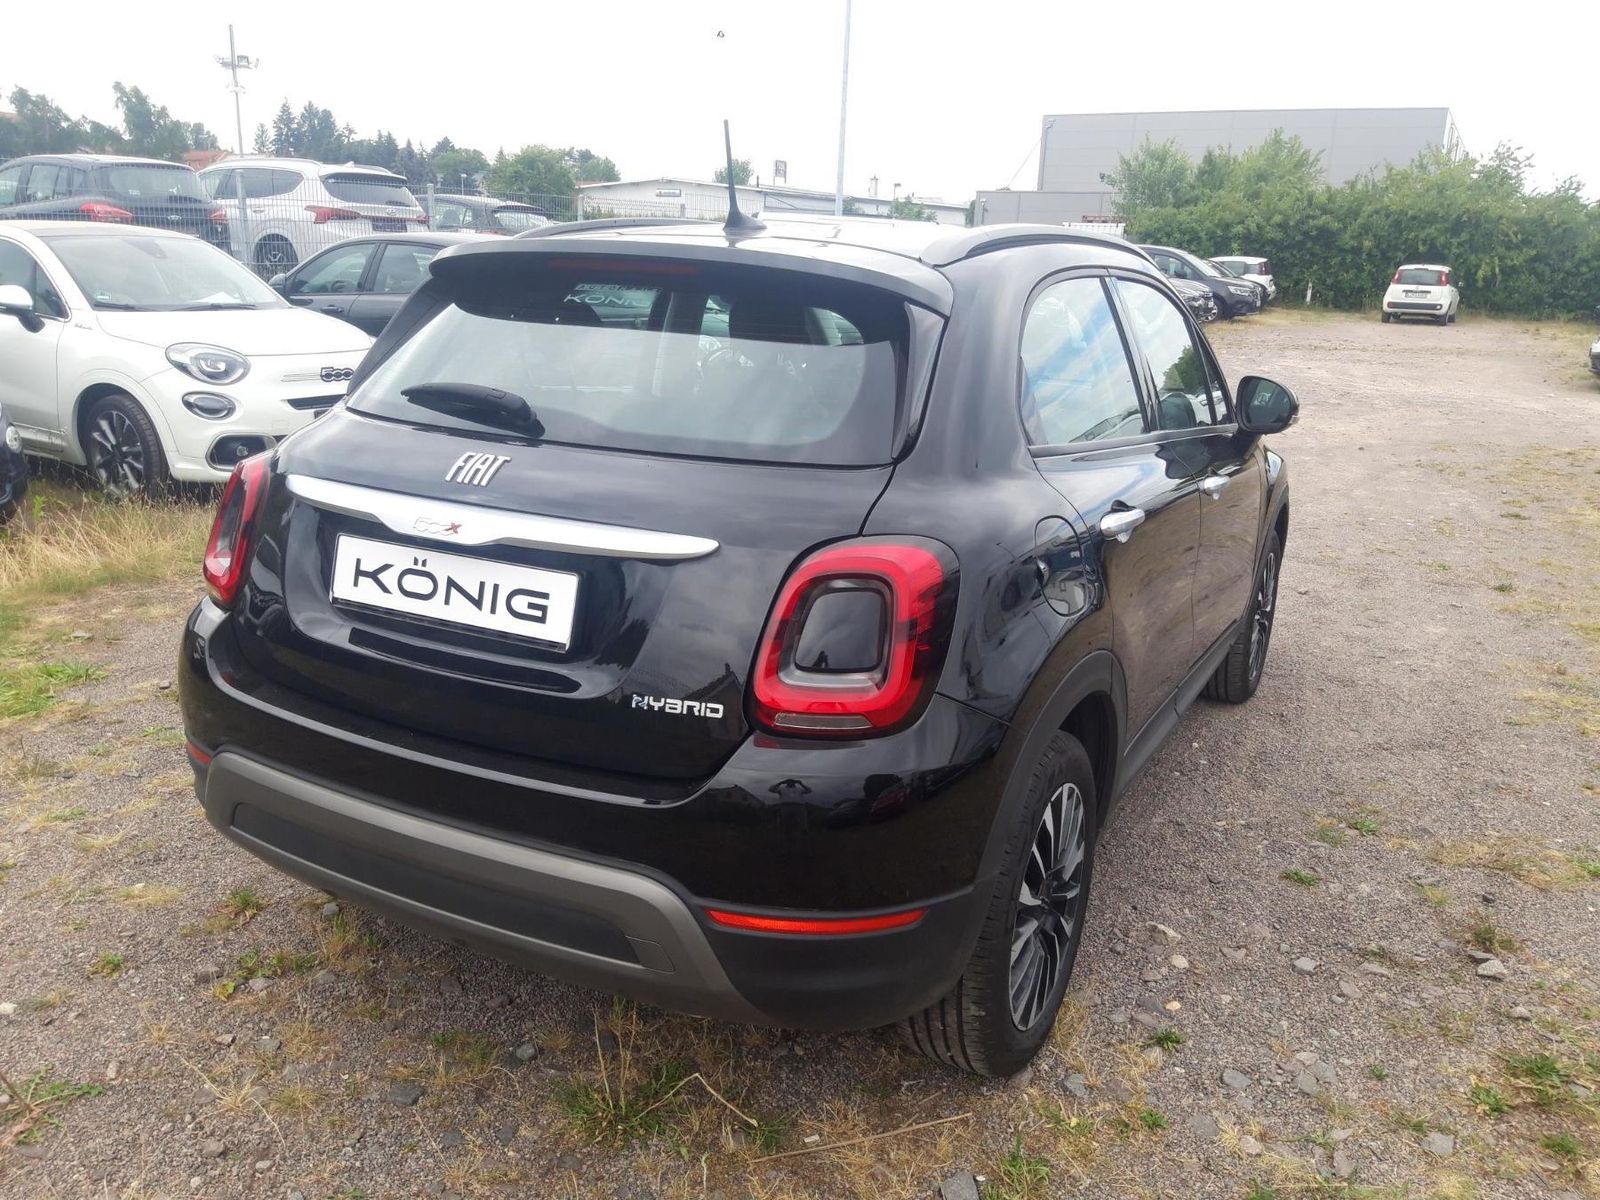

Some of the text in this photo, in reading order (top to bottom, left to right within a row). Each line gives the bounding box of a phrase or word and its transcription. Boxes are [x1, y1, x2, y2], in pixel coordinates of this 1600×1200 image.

[320, 366, 354, 382] 500
[445, 452, 511, 487] FIAT
[353, 556, 550, 624] KÖNIG
[631, 694, 723, 718] HYBRID
